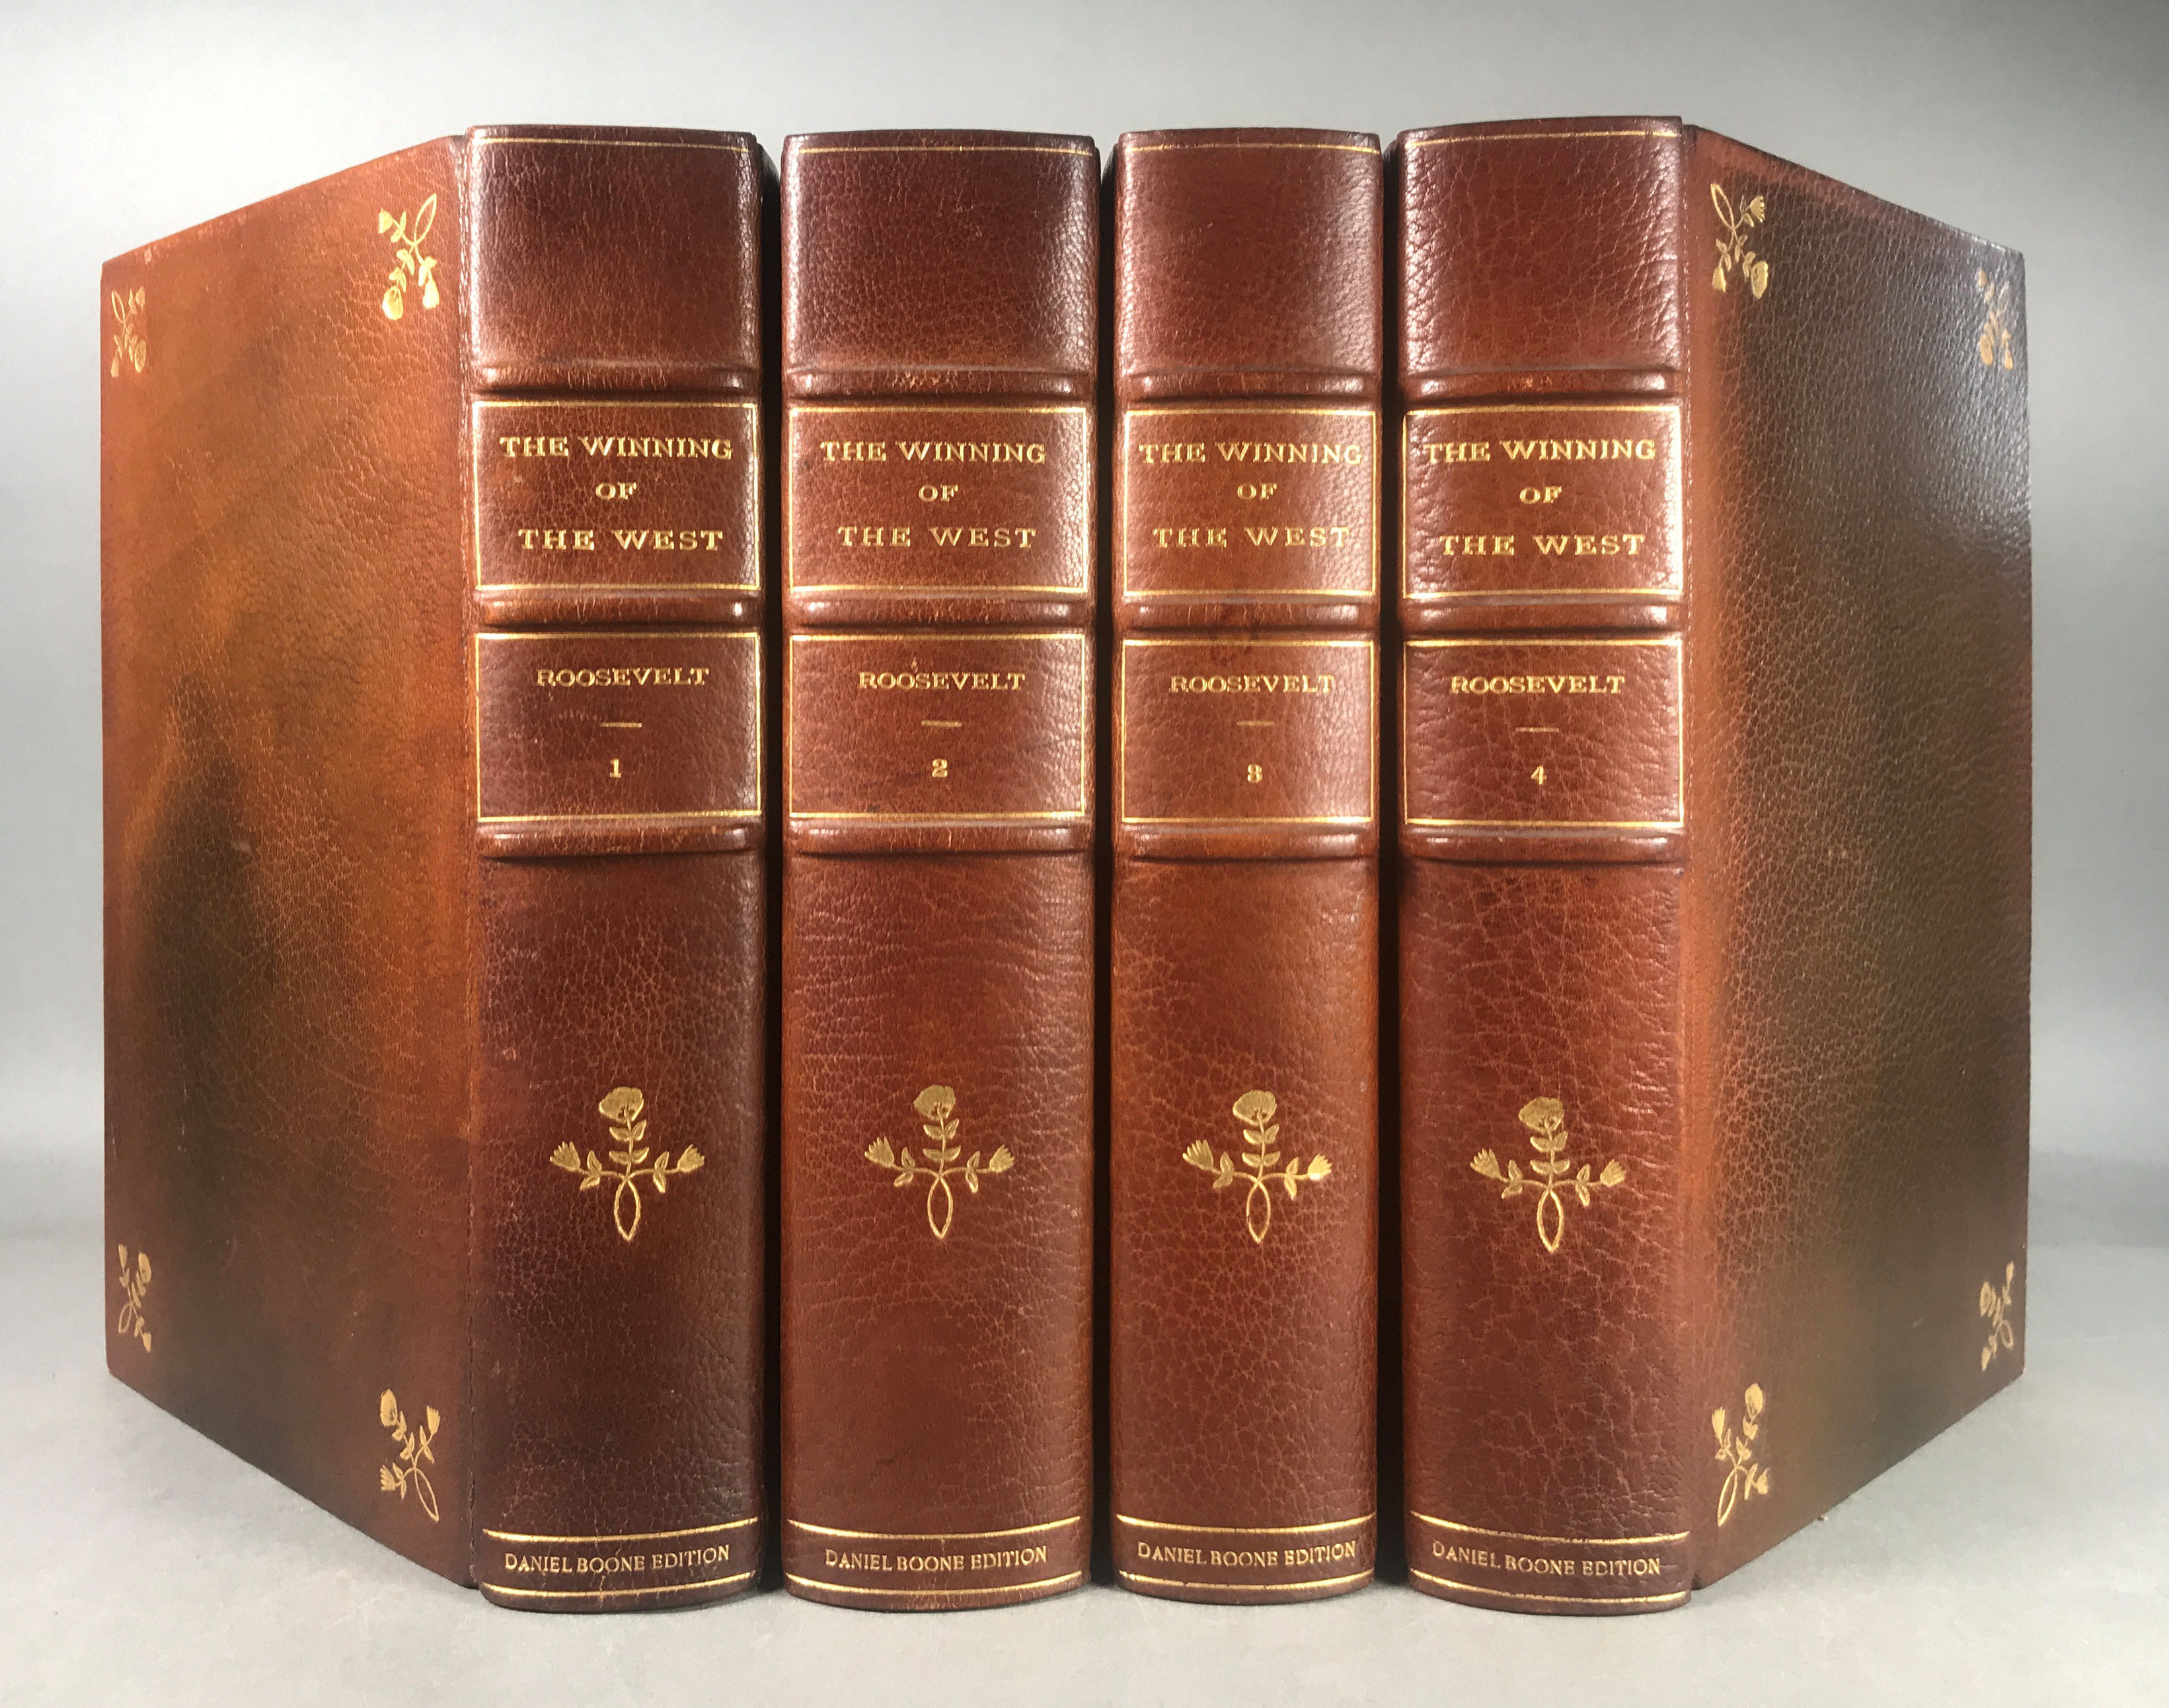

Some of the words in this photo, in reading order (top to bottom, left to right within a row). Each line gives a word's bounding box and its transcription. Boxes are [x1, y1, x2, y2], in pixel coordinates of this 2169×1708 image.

[500, 437, 568, 458] THE
[578, 436, 733, 460] WINNING
[820, 441, 886, 462] THE
[895, 441, 1046, 464] WINNING
[1138, 443, 1205, 464] THE
[1214, 441, 1363, 464] WINNING
[1424, 442, 1490, 463] THE
[1500, 439, 1655, 461] WINNING
[595, 481, 637, 500] OF
[919, 484, 959, 502] OF
[1237, 482, 1277, 500] OF
[1519, 486, 1562, 504] OF
[518, 529, 594, 550] THE
[611, 529, 723, 551] WEST
[838, 527, 911, 547] THE
[929, 527, 1036, 548] WEST
[1153, 527, 1227, 548] THE
[1244, 527, 1351, 548] WEST
[1439, 535, 1515, 556] THE
[1533, 533, 1646, 556] WEST
[536, 667, 710, 687] ROOSEVELT
[858, 672, 1026, 690] ROOSEVELT
[1169, 675, 1335, 694] ROOSEVELT
[1451, 675, 1625, 695] ROOSEVELT
[609, 759, 622, 778] 1
[932, 759, 948, 778] 2
[1531, 765, 1547, 785] 4
[504, 1553, 573, 1573] DANIEL
[576, 1555, 645, 1573] BOONE
[652, 1544, 730, 1570] EDITION
[825, 1549, 893, 1571] DANIEL
[896, 1555, 964, 1572] BOONE
[971, 1545, 1047, 1570] EDITION
[1137, 1541, 1207, 1565] DANIEL
[1210, 1550, 1278, 1567] BOONE
[1284, 1540, 1356, 1566] EDITION
[1432, 1540, 1501, 1569] DANIEL
[1505, 1554, 1575, 1575] BOONE
[1582, 1557, 1660, 1577] EDITION
